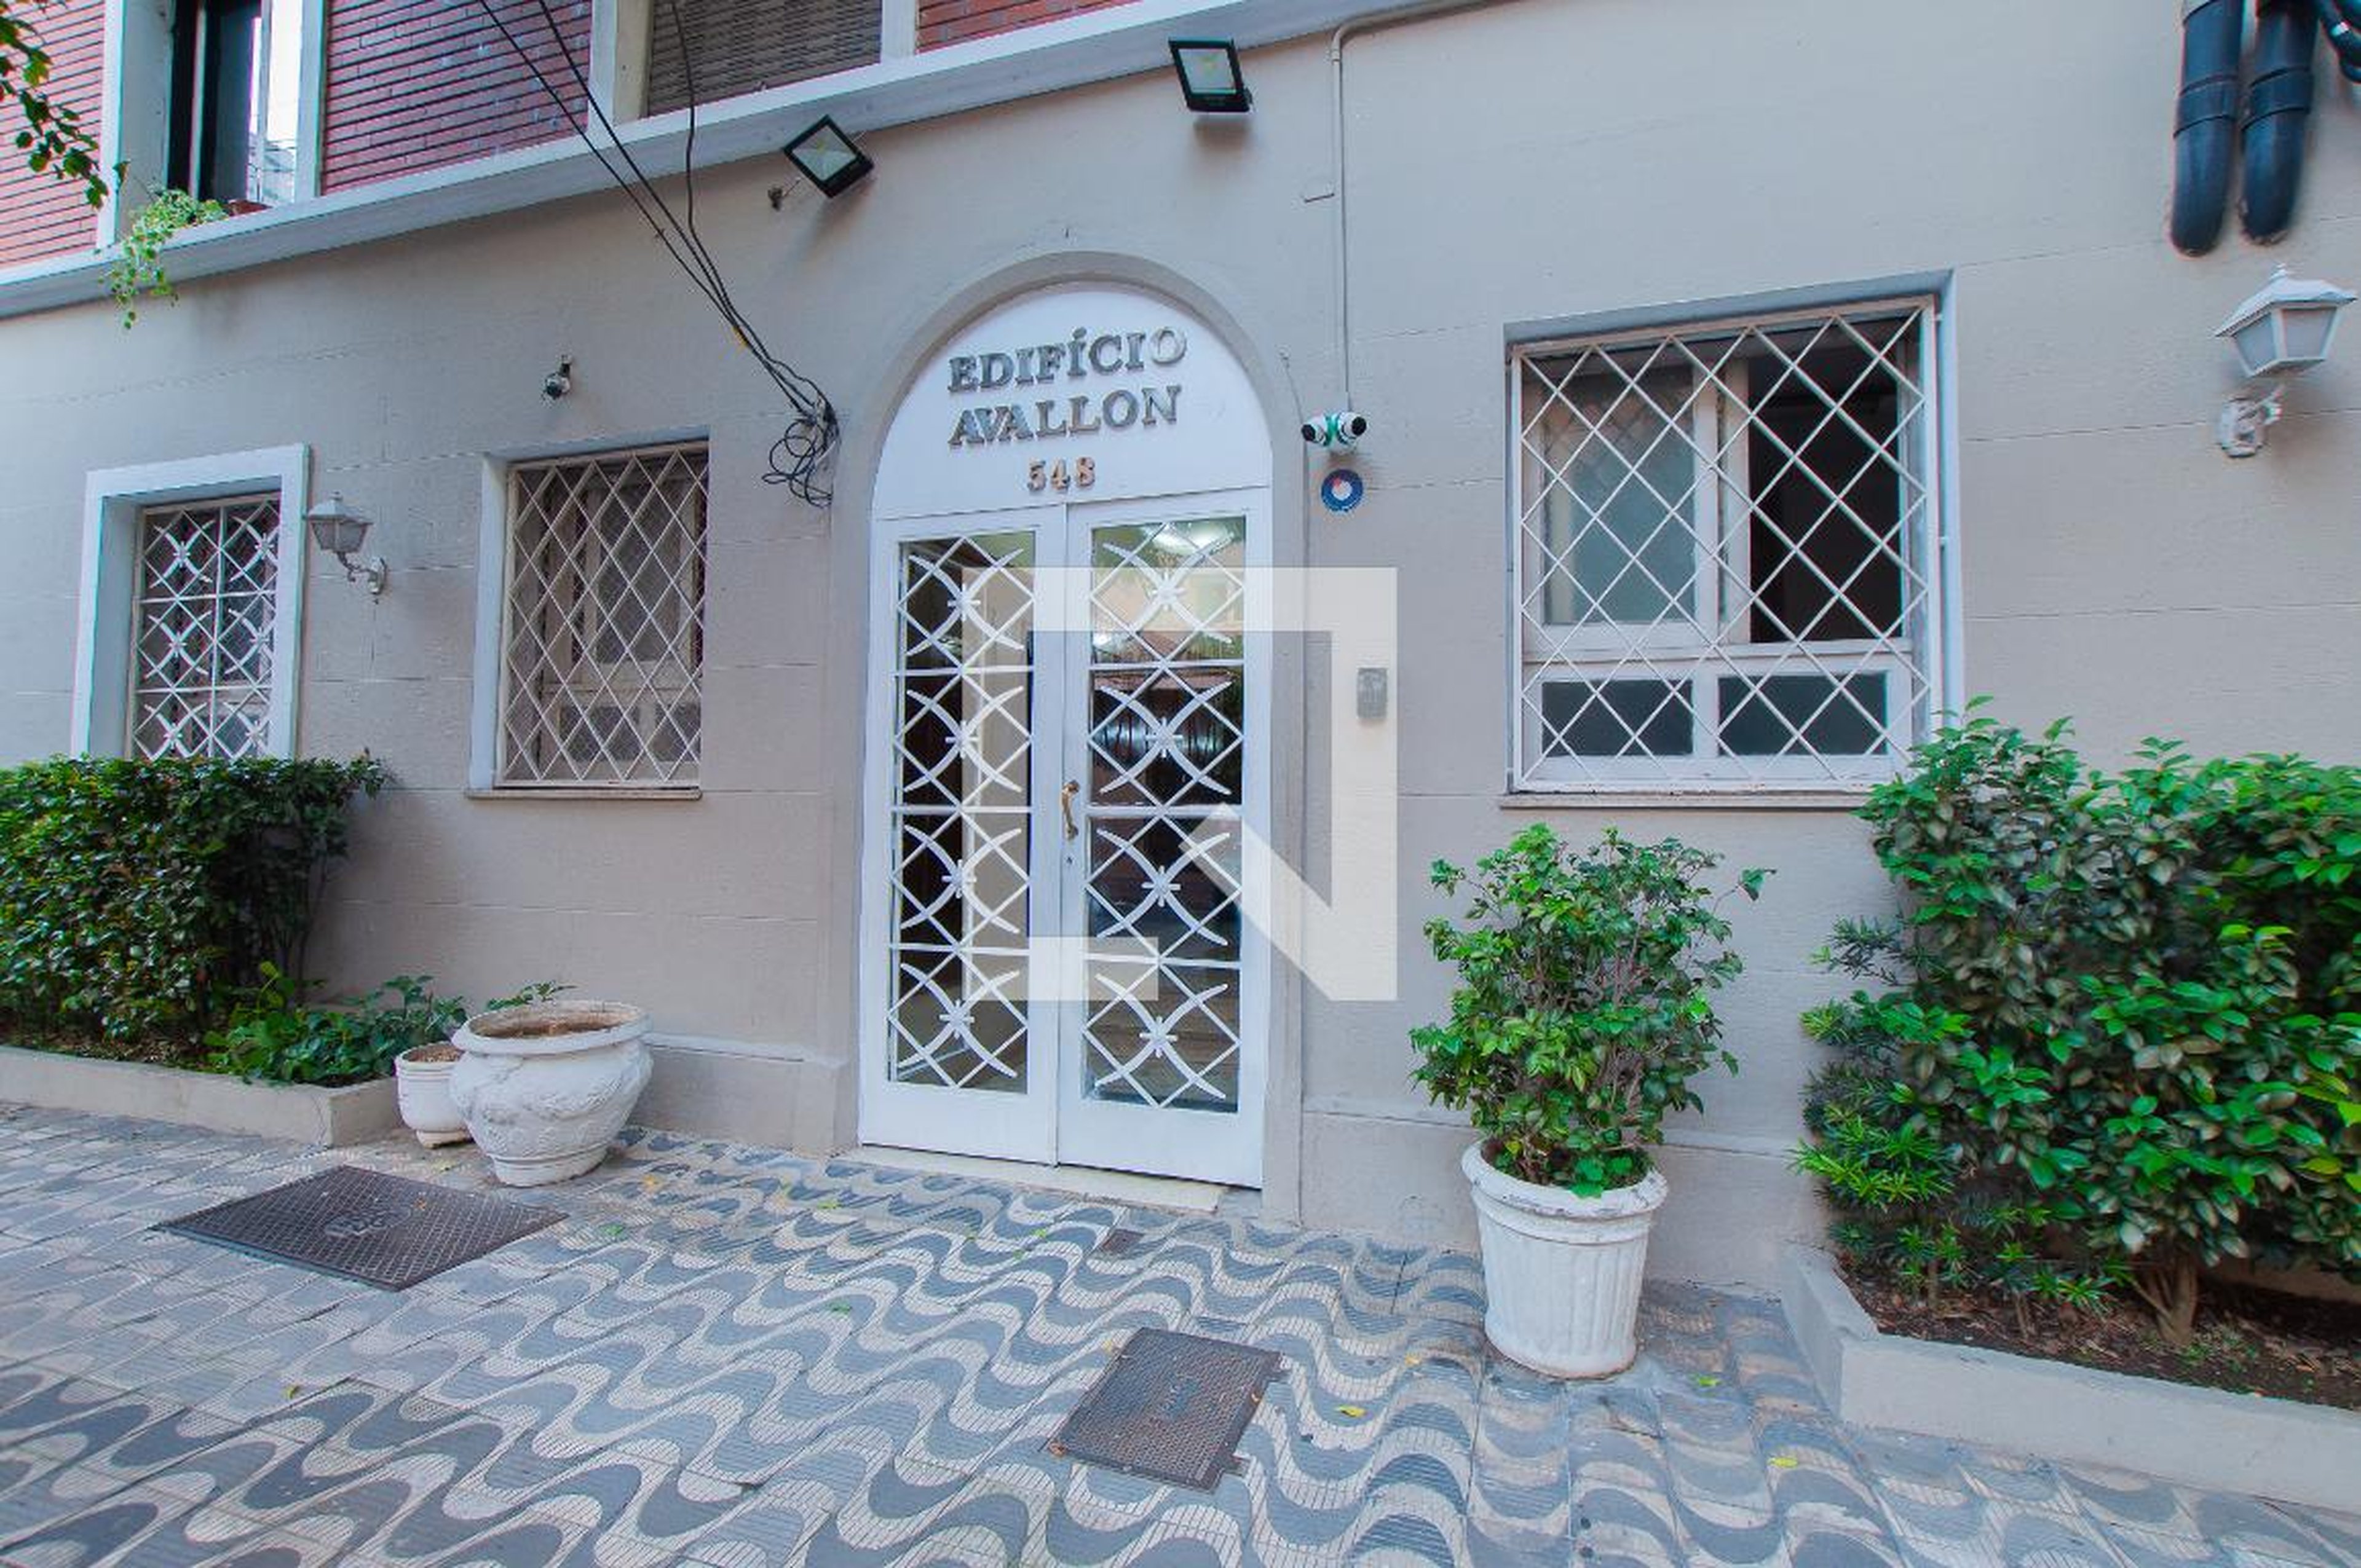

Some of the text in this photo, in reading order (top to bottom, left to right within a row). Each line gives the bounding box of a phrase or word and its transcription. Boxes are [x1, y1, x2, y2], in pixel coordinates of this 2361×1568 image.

[947, 327, 1187, 393] EDIFÍCIO
[948, 384, 1182, 447] AVALLON
[1026, 456, 1096, 492] 548
